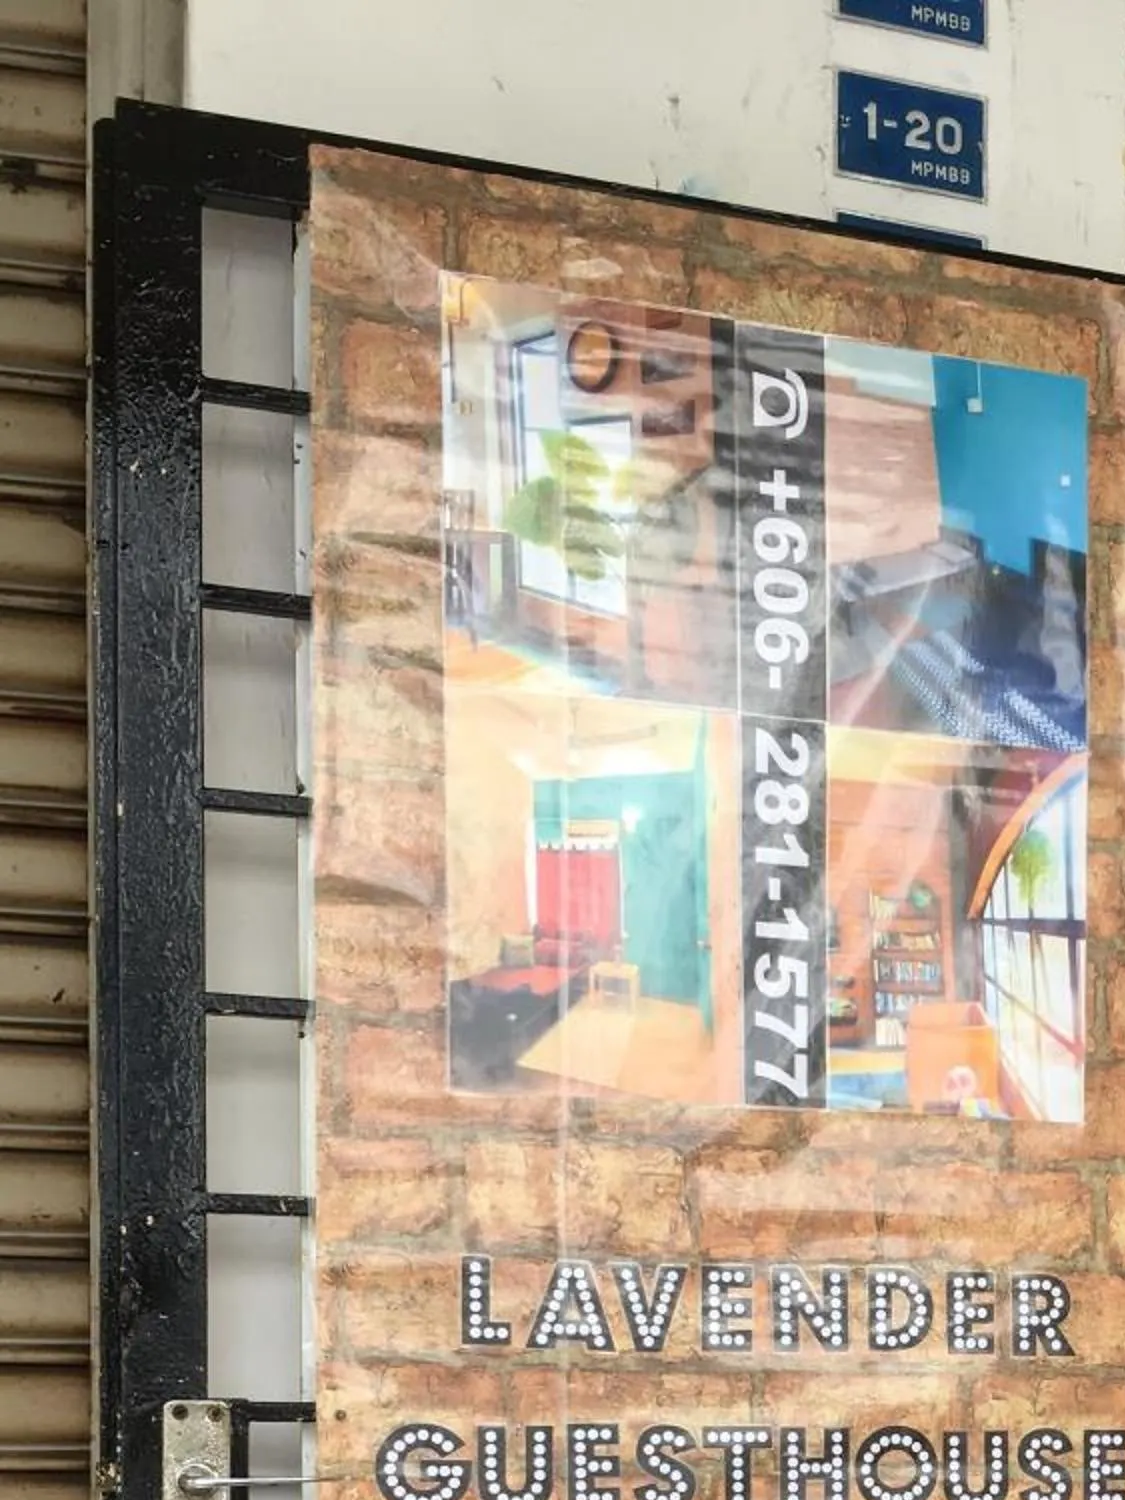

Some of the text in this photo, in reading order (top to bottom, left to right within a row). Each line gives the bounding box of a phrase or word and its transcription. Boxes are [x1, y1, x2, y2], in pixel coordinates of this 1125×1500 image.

[911, 5, 971, 32] MPMBB
[863, 101, 963, 155] 1-20
[911, 159, 971, 185] MPMBB
[752, 468, 811, 1099] +606- 281-1577
[460, 1255, 1076, 1357] LAVENDER
